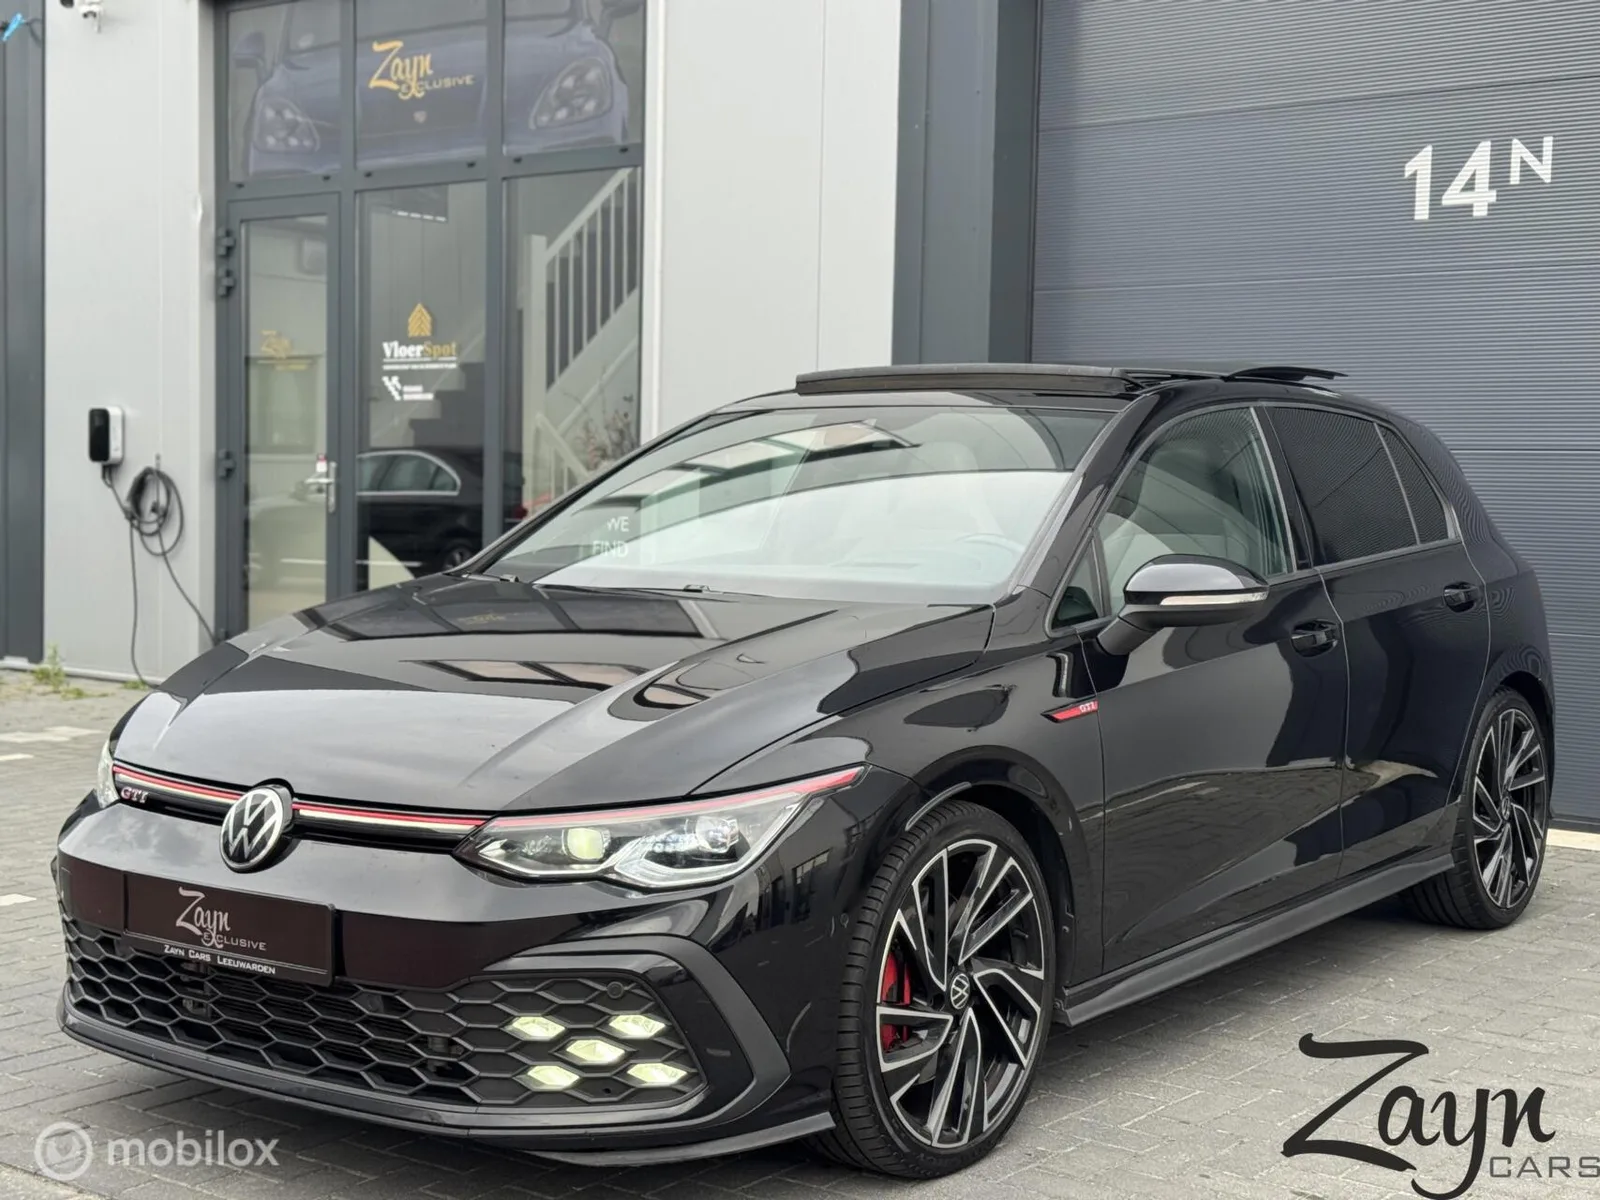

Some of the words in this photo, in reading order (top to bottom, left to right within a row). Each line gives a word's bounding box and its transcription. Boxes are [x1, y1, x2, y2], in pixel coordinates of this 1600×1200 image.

[368, 40, 433, 100] Zayn
[382, 340, 457, 358] VloerSpot
[592, 540, 629, 558] FIND
[1079, 701, 1098, 713] GTI
[120, 786, 148, 803] GTI
[176, 886, 230, 948] Zayn
[164, 944, 185, 957] ZAYN
[188, 949, 211, 962] CARS
[217, 955, 276, 975] LEEUWARDEN
